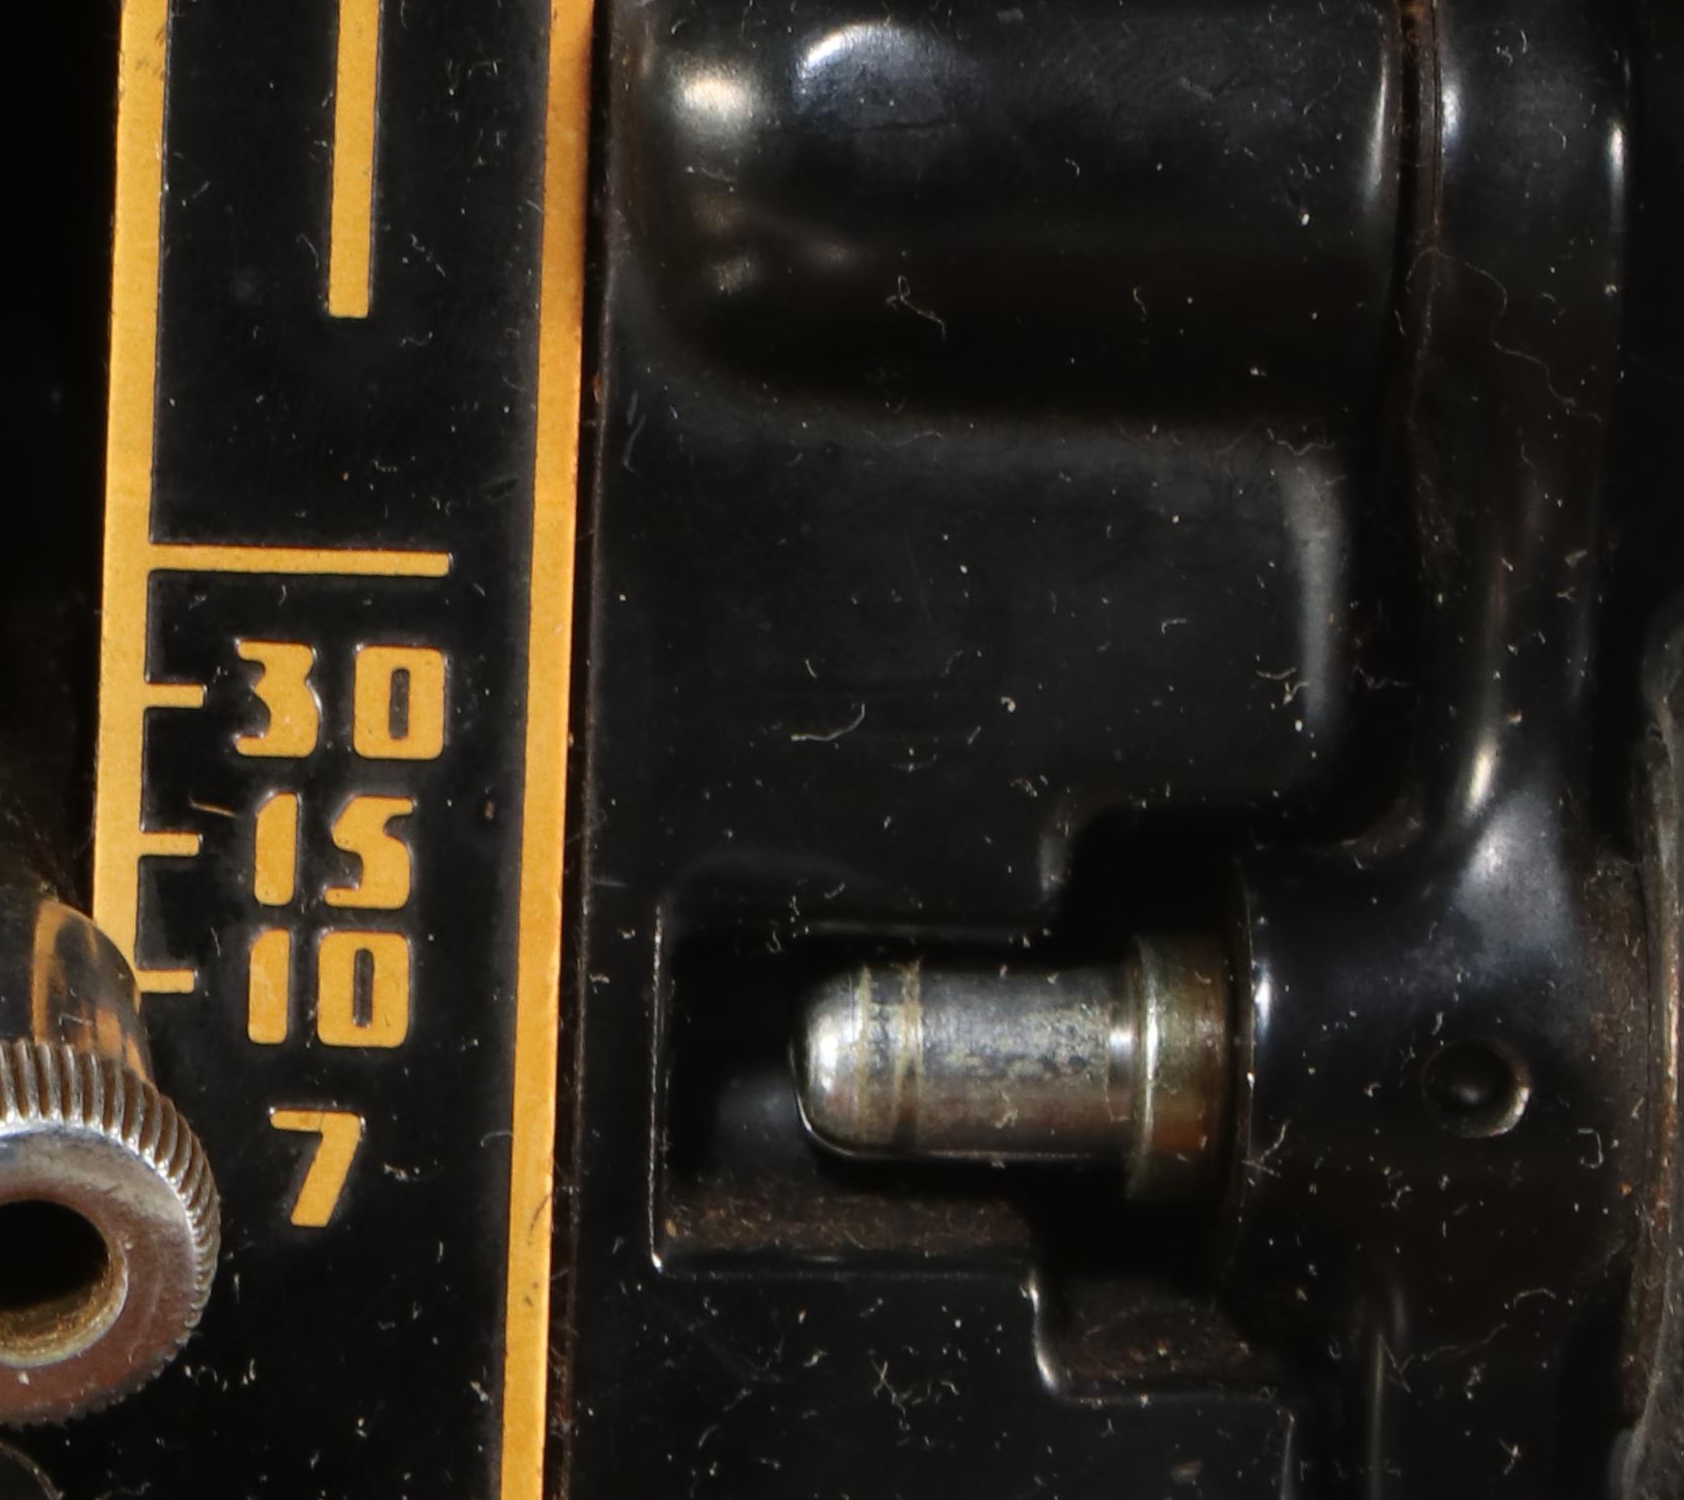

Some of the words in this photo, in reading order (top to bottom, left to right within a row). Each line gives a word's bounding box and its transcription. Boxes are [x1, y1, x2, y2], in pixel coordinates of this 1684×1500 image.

[234, 640, 447, 761] 30
[252, 790, 415, 909] 15
[246, 926, 412, 1047] 10
[269, 1107, 365, 1228] 7
